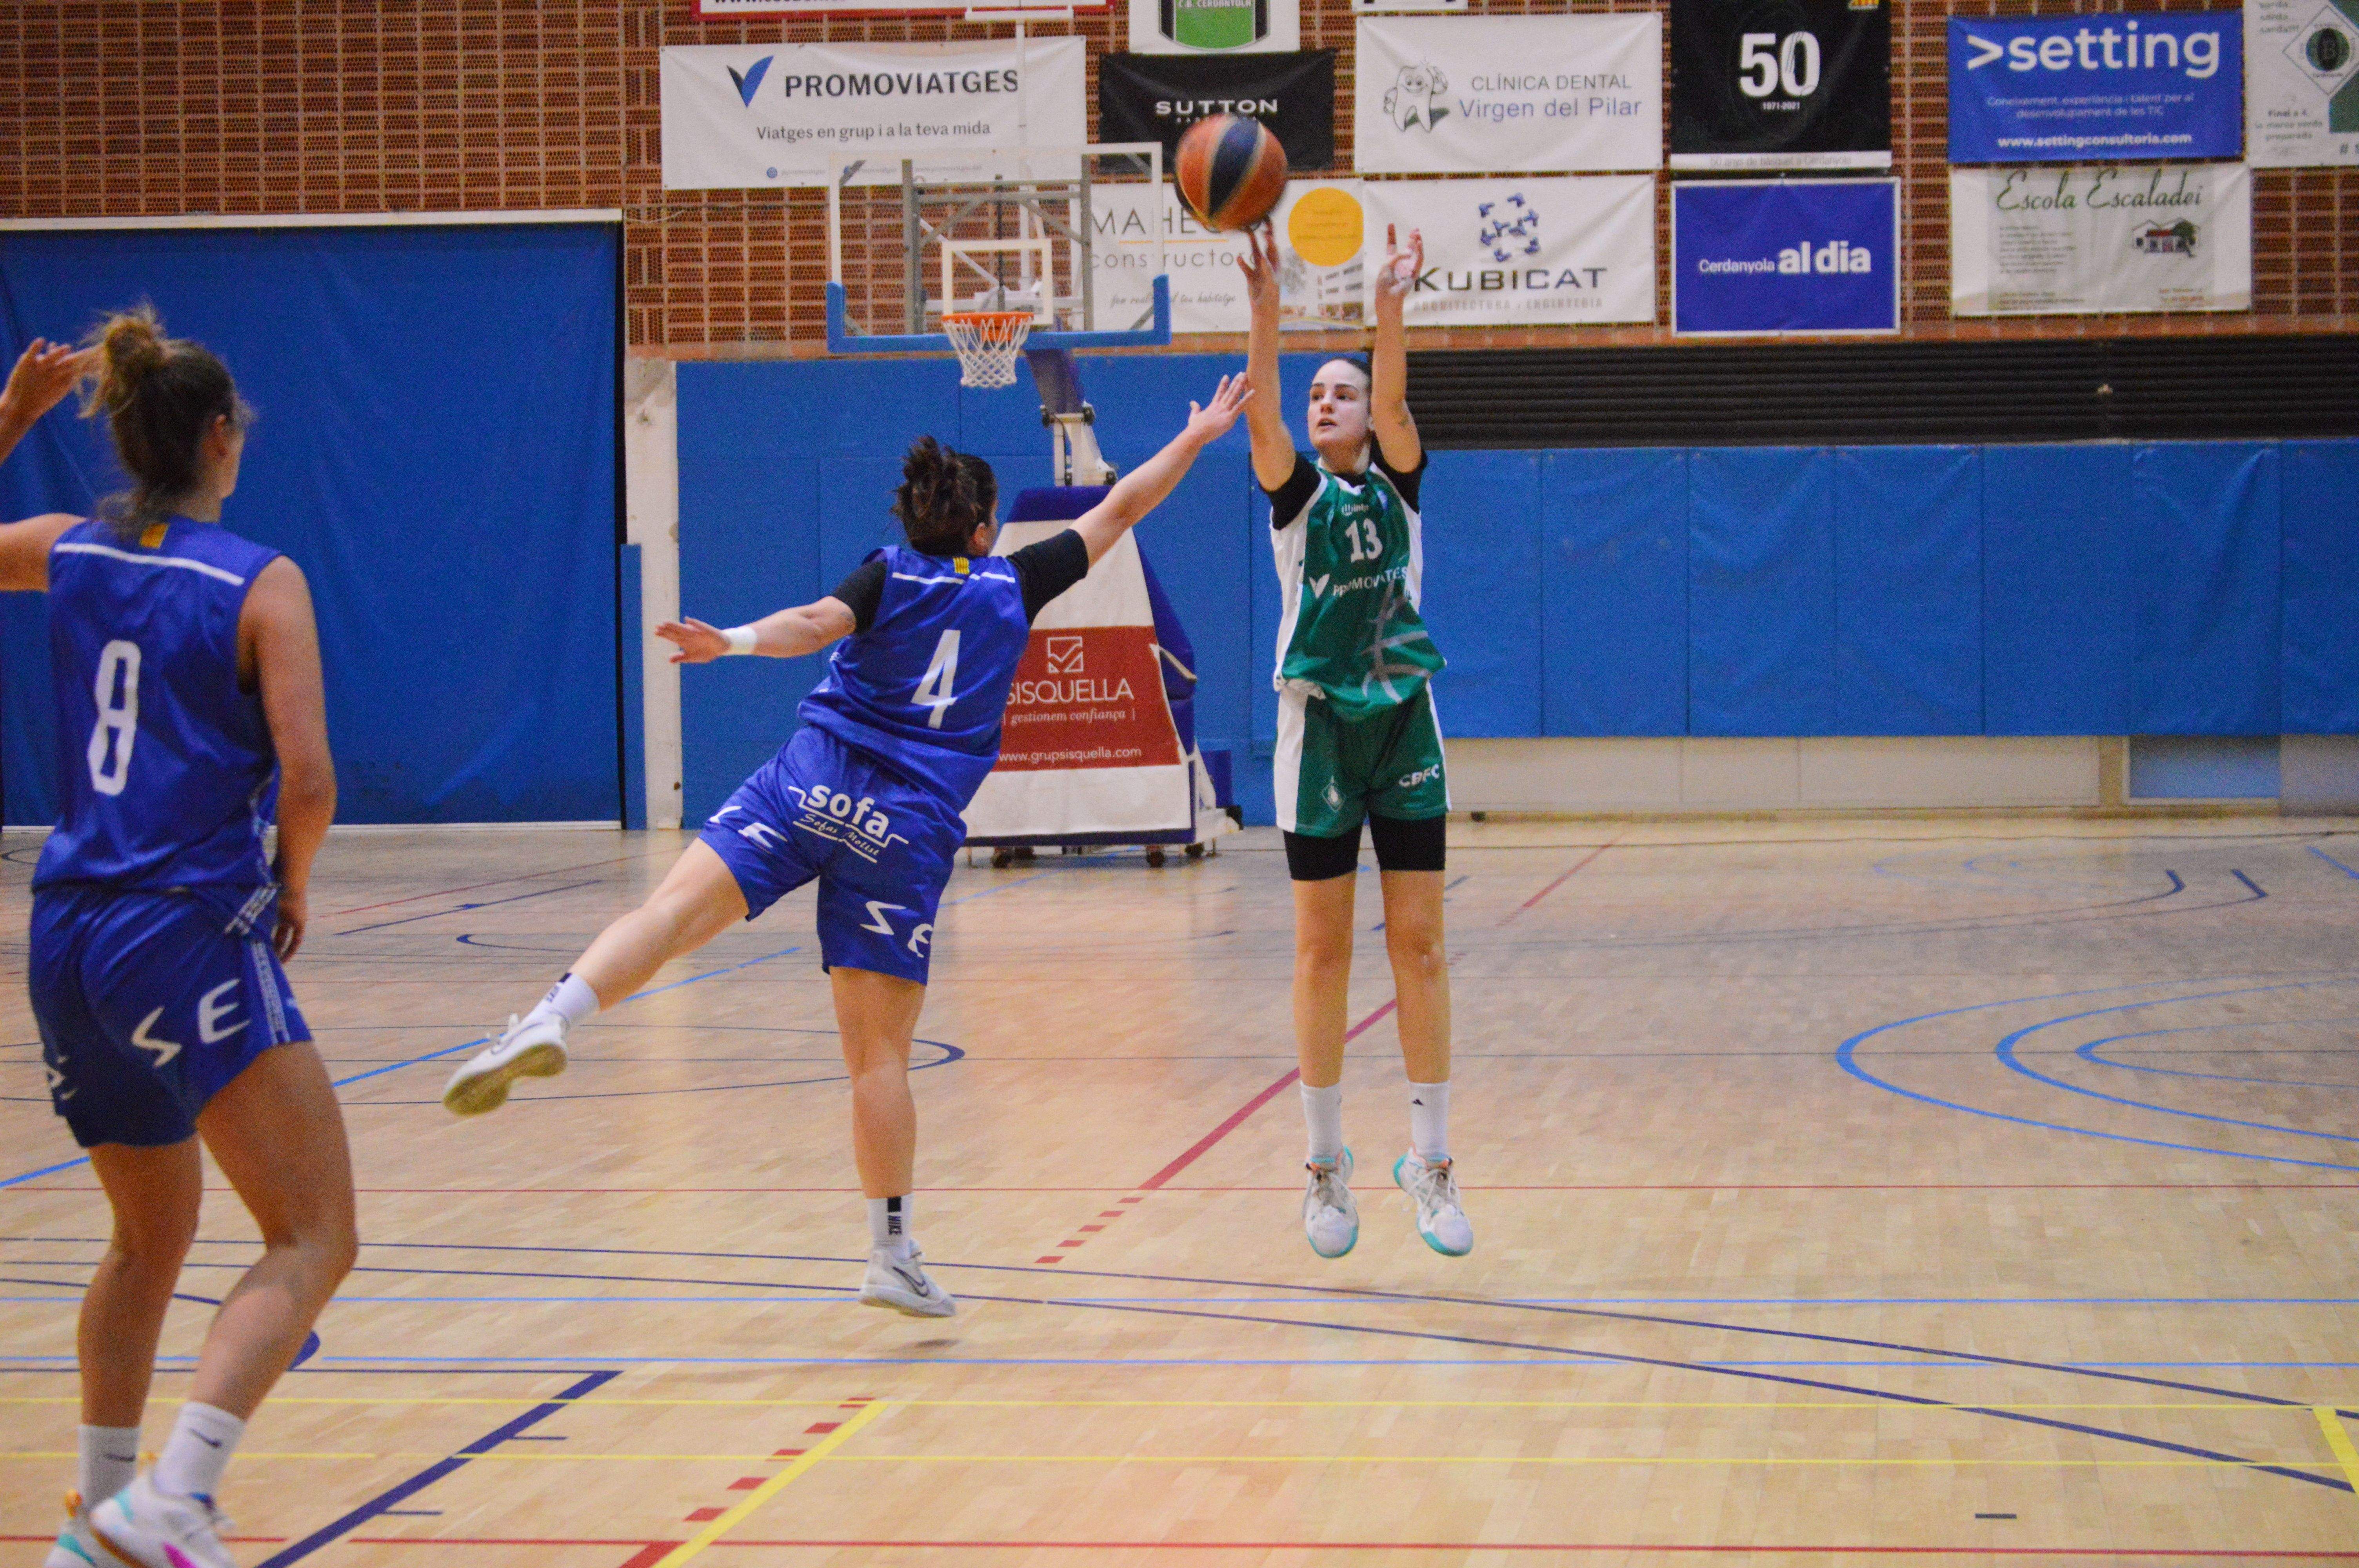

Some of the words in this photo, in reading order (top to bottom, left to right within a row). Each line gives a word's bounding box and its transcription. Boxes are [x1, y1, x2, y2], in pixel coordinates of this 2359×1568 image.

[1739, 31, 1820, 97] 50
[785, 69, 1018, 97] PROMOVIATGES
[1471, 73, 1549, 91] CLÍNICA
[1556, 74, 1632, 90] DENTAL
[1156, 99, 1278, 114] SUTTON
[1459, 99, 1534, 122] Virgen
[1545, 98, 1579, 116] del
[1589, 97, 1642, 116] Pilar
[756, 126, 813, 143] Viatges
[818, 127, 835, 138] en
[839, 127, 874, 142] grup
[879, 124, 882, 136] i
[887, 126, 895, 136] a
[900, 122, 912, 136] la
[916, 123, 949, 136] teva
[953, 120, 991, 135] mida
[1997, 132, 2192, 149] www.settingconsultoria.com
[1996, 169, 2077, 211] Escola
[2086, 166, 2203, 208] Escaladei
[1698, 258, 1775, 274] Cerdanyola
[1779, 241, 1810, 274] al
[1815, 240, 1872, 273] dia
[1414, 267, 1608, 292] KUBICAT
[1345, 518, 1383, 563] 13
[911, 629, 961, 729] 4
[87, 639, 142, 796] 8
[1011, 712, 1067, 726] gestionem
[1070, 708, 1126, 724] confiança
[999, 746, 1142, 764] www.grupsisquella.com
[807, 785, 889, 838] sofa
